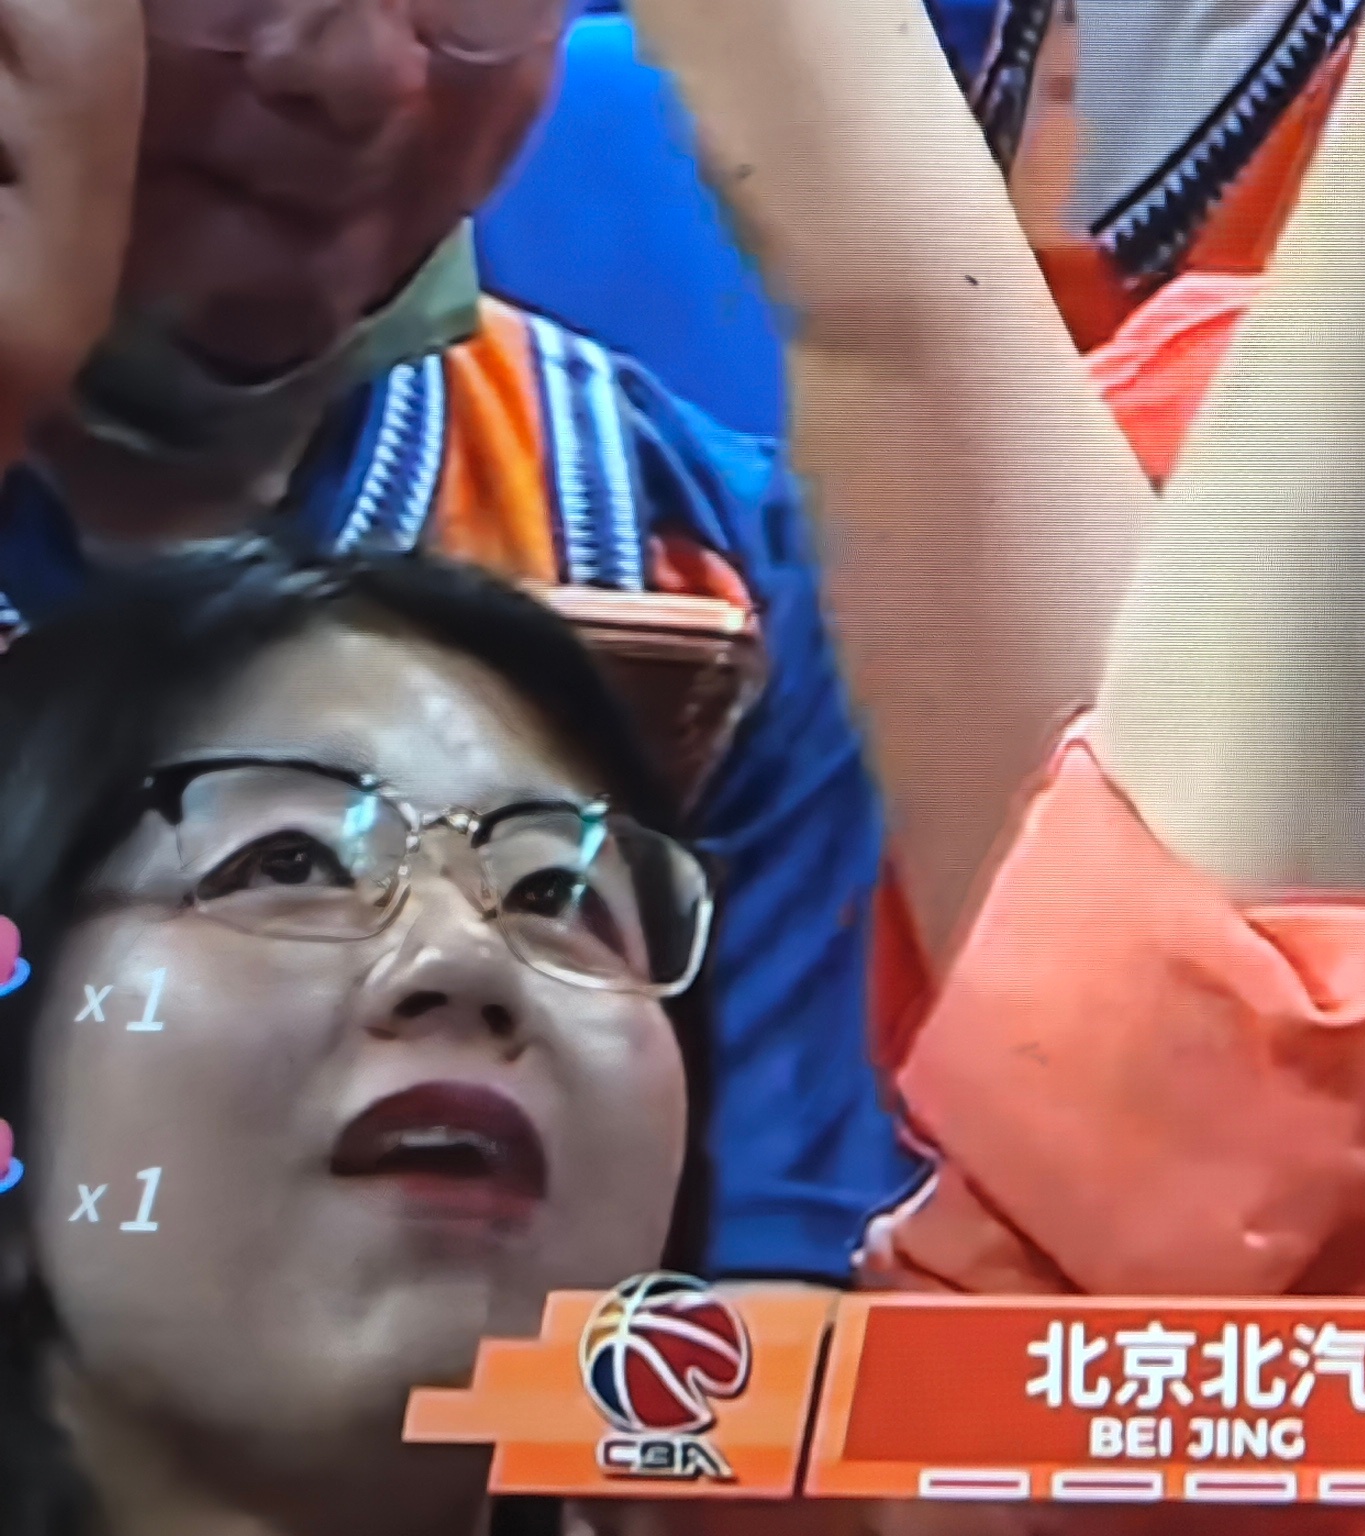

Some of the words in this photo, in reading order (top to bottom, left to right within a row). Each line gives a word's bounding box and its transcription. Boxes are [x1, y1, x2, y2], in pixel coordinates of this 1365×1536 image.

[597, 1434, 733, 1478] CBA
[1089, 1417, 1173, 1459] BEI
[1187, 1417, 1306, 1461] JING
